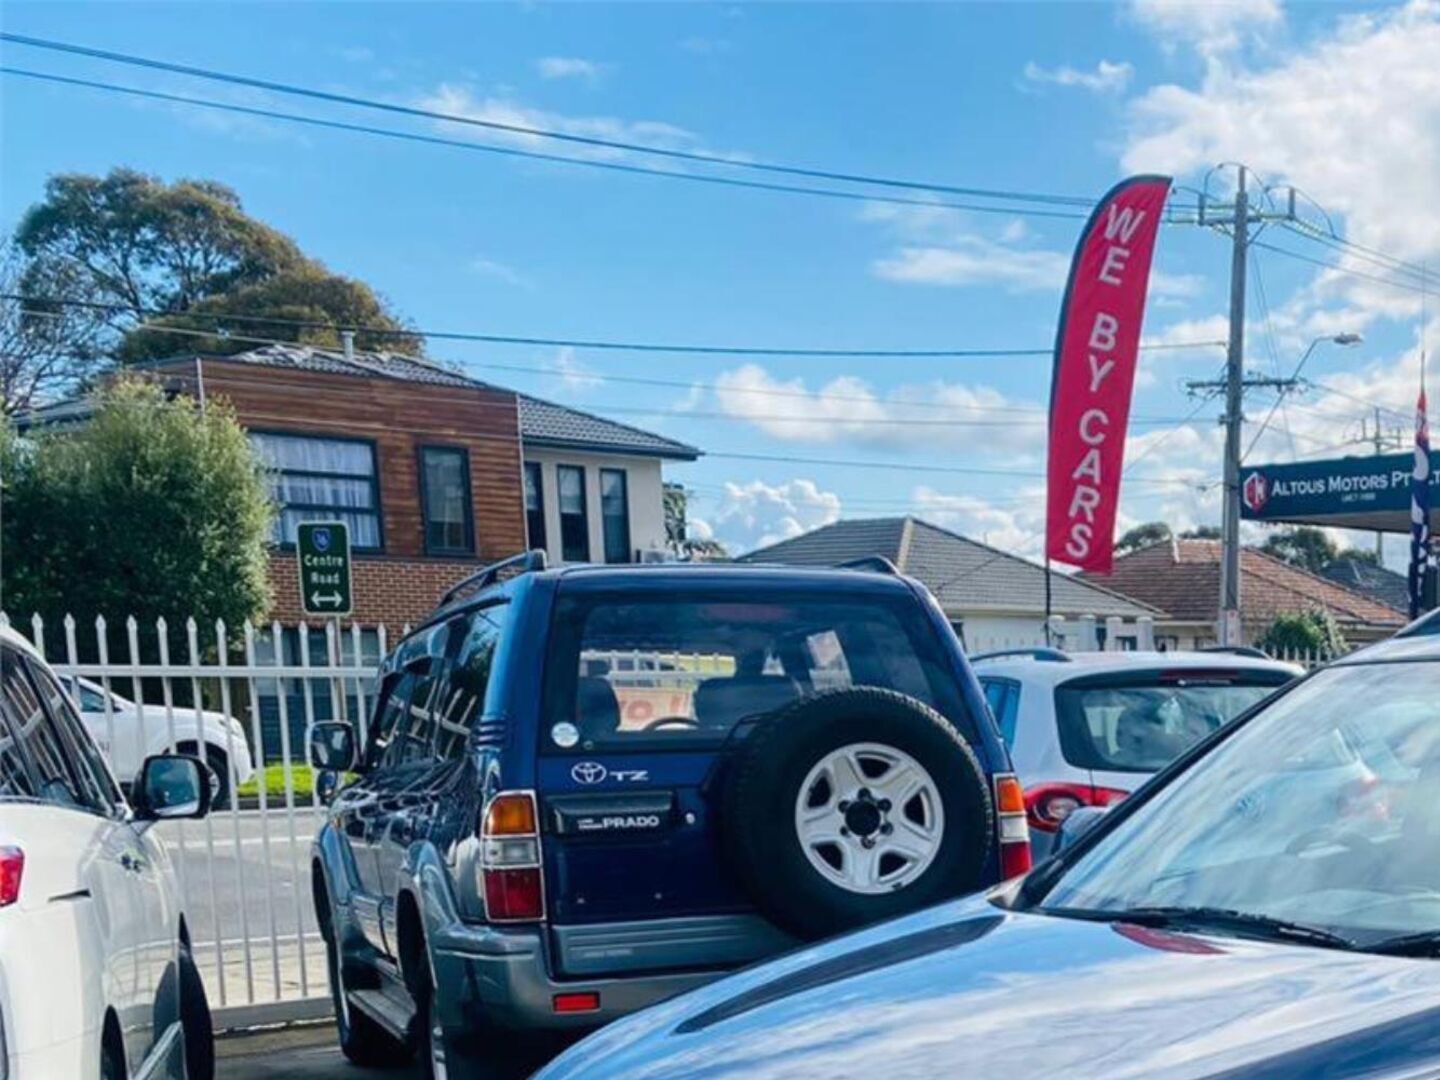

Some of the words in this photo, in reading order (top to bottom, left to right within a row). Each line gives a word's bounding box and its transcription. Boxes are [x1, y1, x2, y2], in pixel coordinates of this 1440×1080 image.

[1099, 203, 1144, 285] WE
[1089, 313, 1118, 392] BY
[1066, 409, 1109, 558] CARS
[1271, 479, 1326, 497] ALTOUS
[1328, 475, 1389, 492] MOTORS
[1391, 471, 1412, 487] PT
[304, 553, 343, 567] Centre
[310, 571, 340, 585] Road
[609, 770, 649, 781] TZ
[602, 816, 660, 829] PRADO
